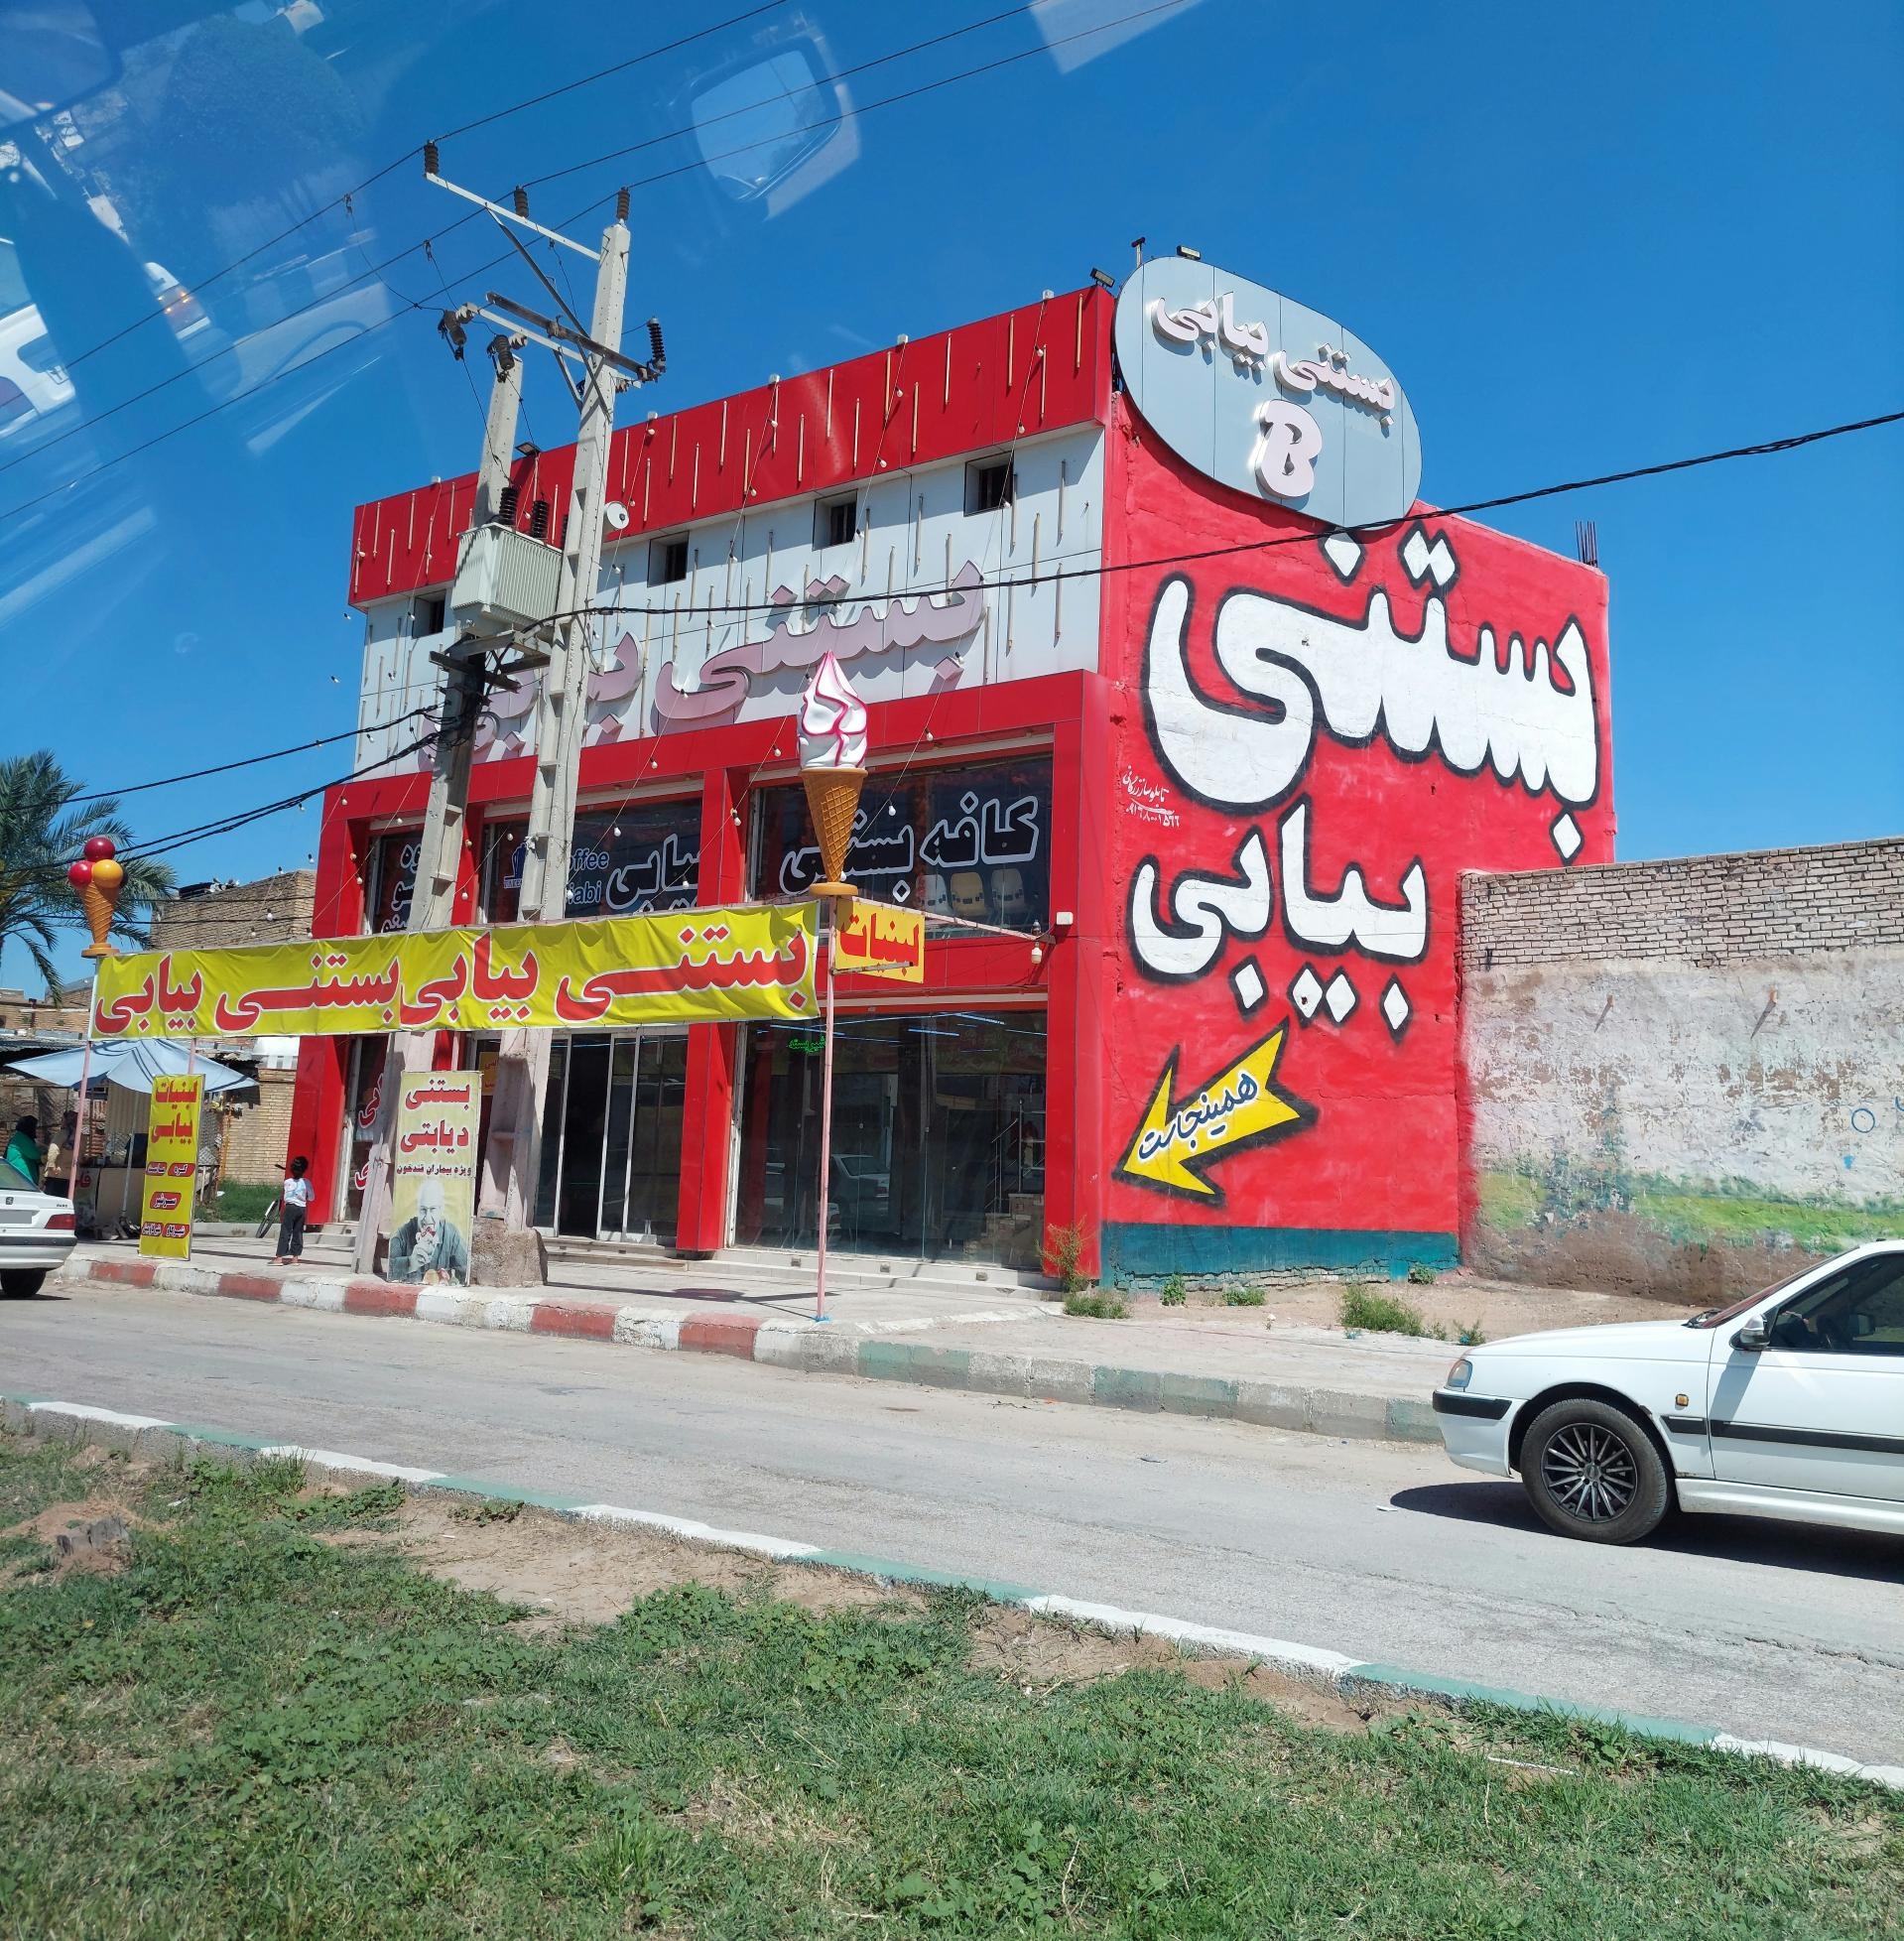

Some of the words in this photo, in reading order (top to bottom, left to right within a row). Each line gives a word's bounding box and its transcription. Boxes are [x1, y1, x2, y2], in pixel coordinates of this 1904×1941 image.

[1151, 291, 1269, 371] بیابی
[1274, 342, 1395, 427] بستنی
[1254, 399, 1324, 497] B
[655, 560, 986, 720] بستنی
[420, 631, 643, 760] ببی
[1141, 522, 1601, 865] بستنی
[779, 808, 915, 903] بستی
[919, 791, 1040, 868] کافه
[838, 912, 921, 977] لبنیات
[1129, 792, 1431, 1046] بیابی
[94, 952, 203, 1035] بیابی
[214, 953, 401, 1032] بستنی
[399, 930, 540, 1026] بیابی
[554, 924, 811, 1023] بستنی
[151, 1111, 193, 1144] بیابی
[155, 1079, 198, 1110] لبنیات
[405, 1079, 470, 1110] بستنی
[1138, 1072, 1259, 1160] همینجاست
[400, 1119, 469, 1154] دیابتی
[426, 1163, 452, 1177] بیماران
[453, 1164, 472, 1177] ویژه
